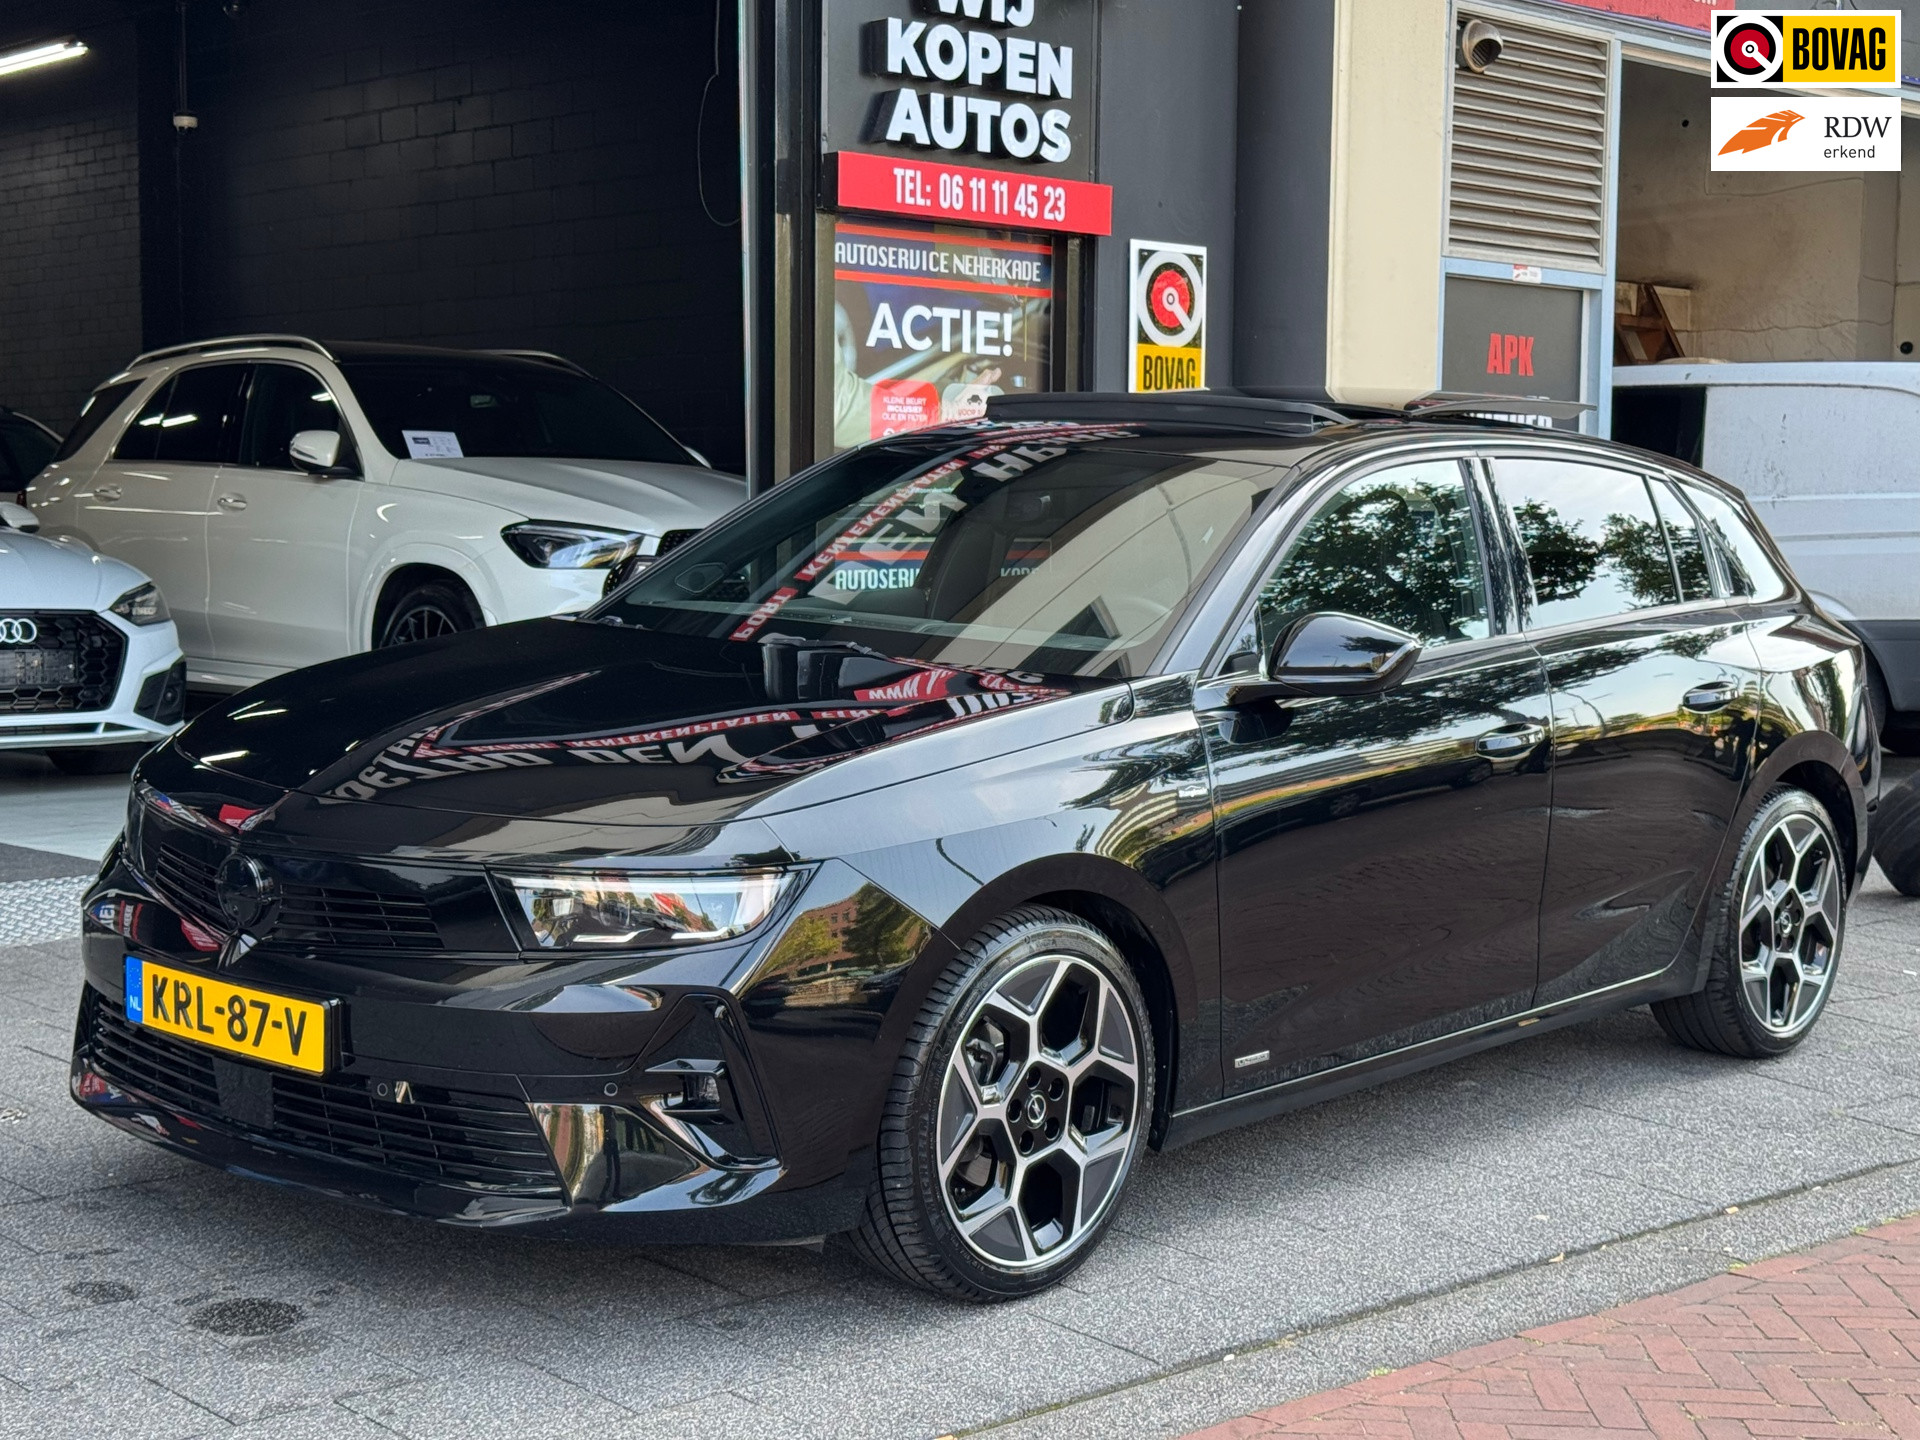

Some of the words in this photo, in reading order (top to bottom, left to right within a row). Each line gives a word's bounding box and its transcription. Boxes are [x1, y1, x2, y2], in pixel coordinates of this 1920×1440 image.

[887, 17, 1073, 99] KOPEN
[886, 88, 1072, 163] AUTOS
[893, 167, 932, 207] TEL:
[939, 173, 964, 210] 06
[969, 177, 986, 213] 11
[992, 180, 1008, 215] 11
[1013, 183, 1037, 219] 45
[1043, 186, 1066, 222] 23
[835, 242, 949, 274] AUTOSERVICE
[953, 254, 1041, 282] NEHERKADE
[865, 302, 1013, 357] ACTIE!
[1487, 333, 1534, 376] APK
[1143, 355, 1196, 390] BOVAG
[130, 996, 141, 1012] NL
[152, 974, 306, 1056] KRL-87-V
